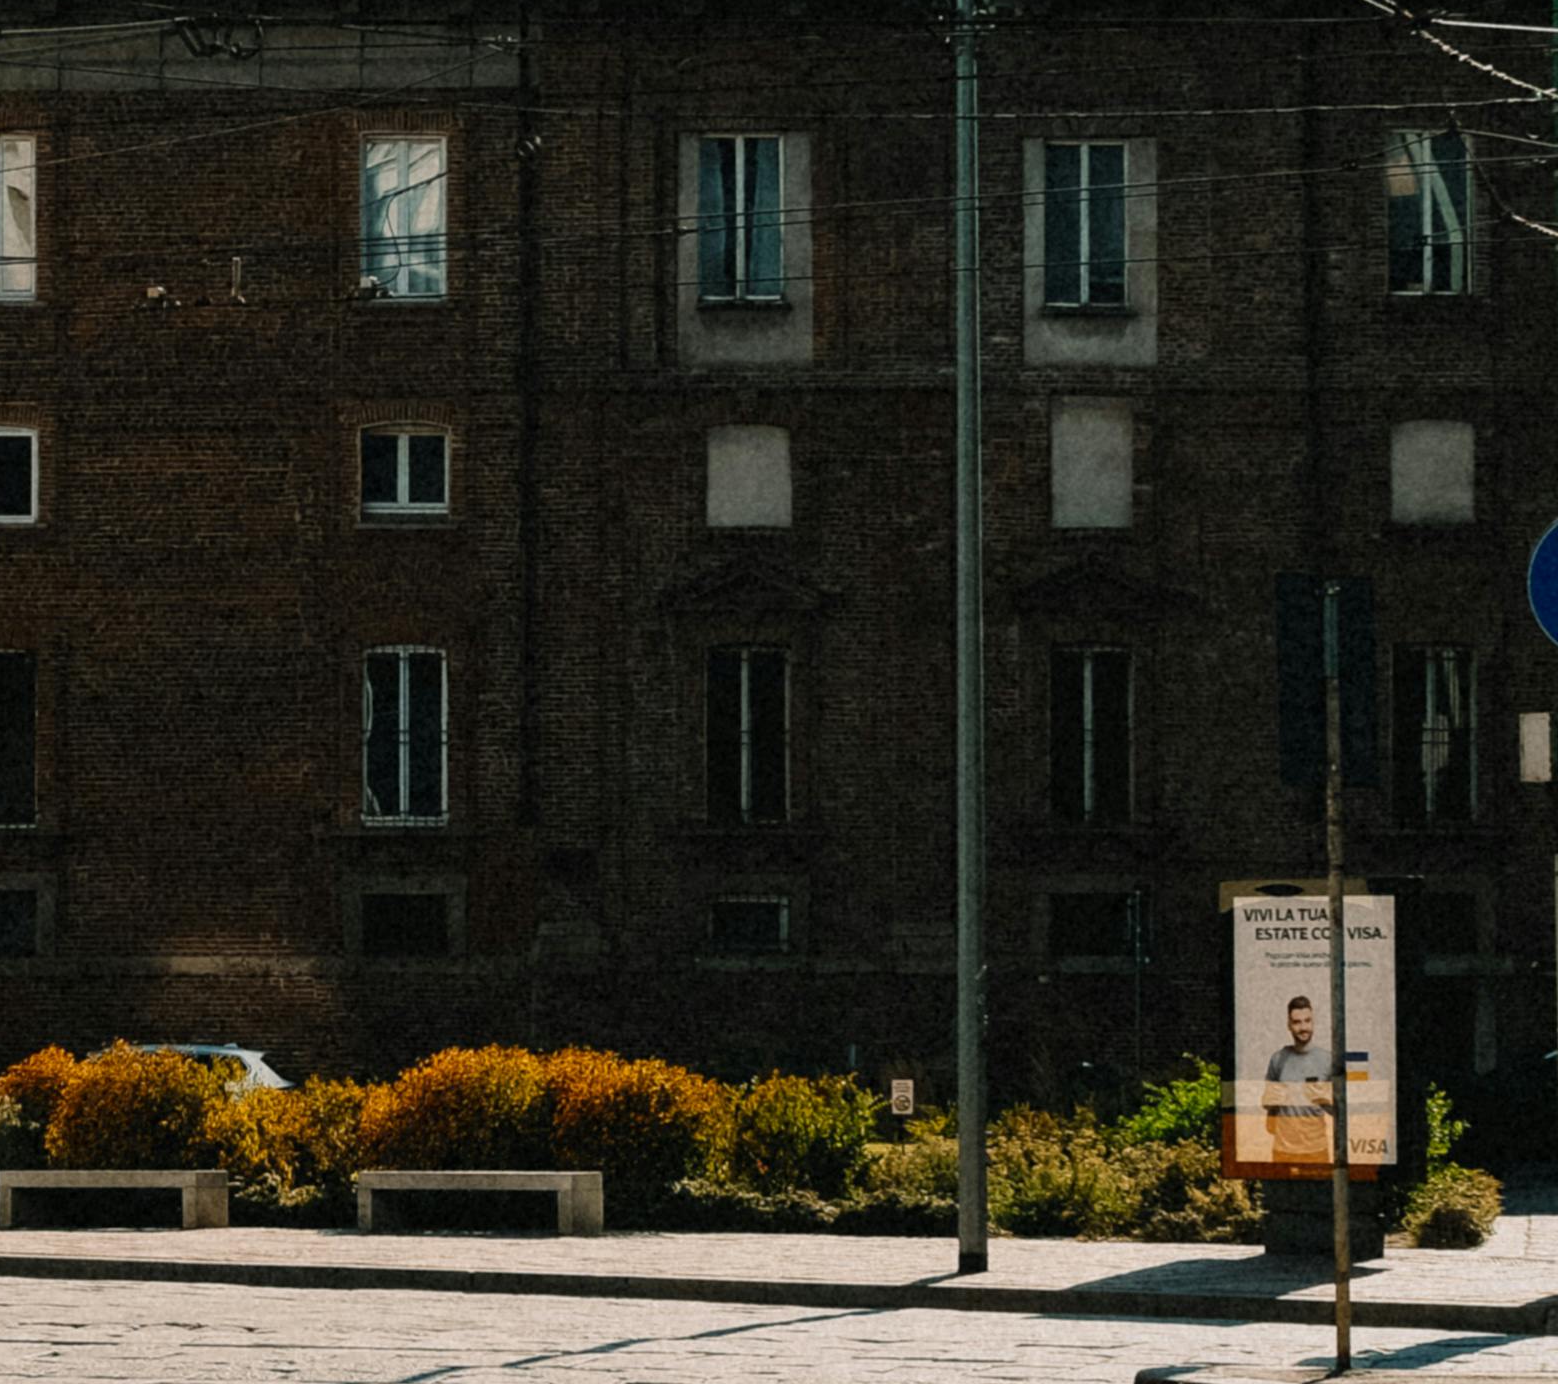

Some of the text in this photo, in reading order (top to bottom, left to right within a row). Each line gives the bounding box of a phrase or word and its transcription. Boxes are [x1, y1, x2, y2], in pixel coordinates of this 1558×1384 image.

[1244, 908, 1273, 922] VIVI
[1276, 908, 1294, 921] LA
[1255, 927, 1308, 941] ESTATE
[1350, 1138, 1388, 1154] VISA
